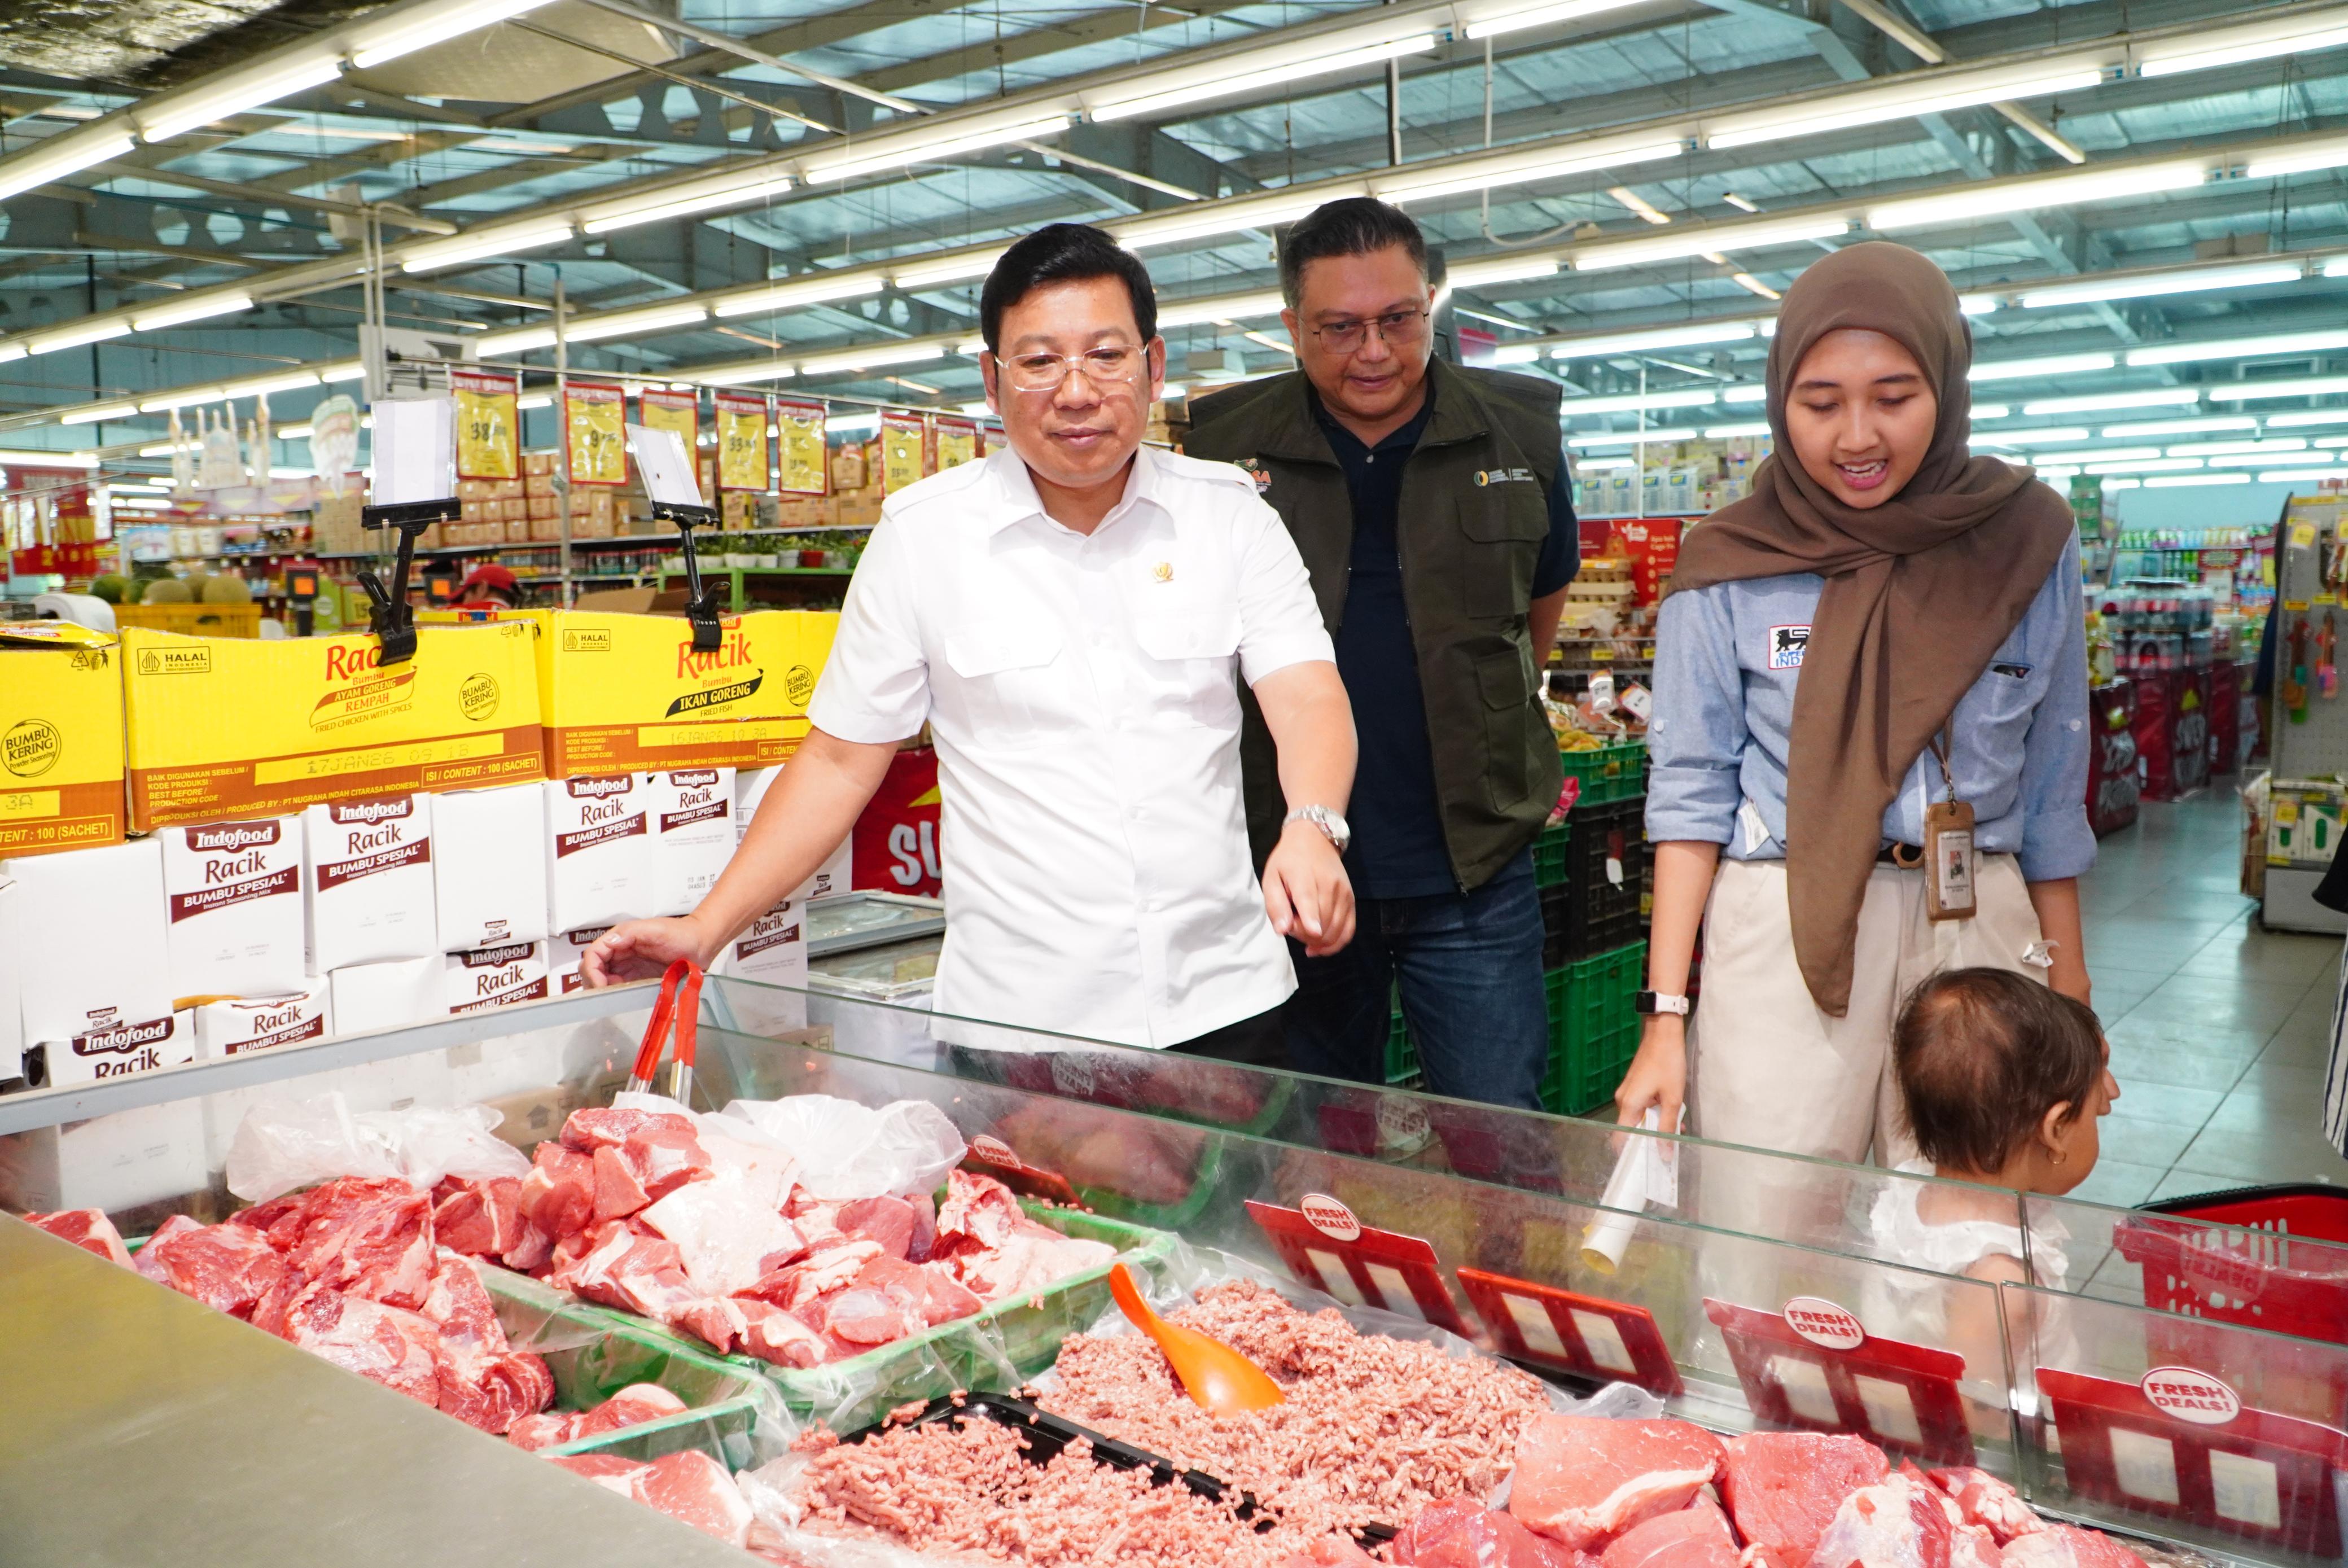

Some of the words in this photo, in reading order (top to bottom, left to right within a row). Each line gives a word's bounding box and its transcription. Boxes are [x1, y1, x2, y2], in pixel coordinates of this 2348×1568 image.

[165, 653, 207, 662] HALAL
[353, 672, 384, 686] Bumbu
[702, 677, 732, 688] Bumbu
[787, 671, 809, 687] BUMBU
[789, 679, 811, 695] KERING
[335, 689, 361, 702] AYAM
[363, 679, 396, 695] GORENG
[462, 680, 492, 699] BUMBU
[464, 689, 494, 709] KERING
[680, 693, 707, 710] IKAN
[711, 683, 751, 703] GORENG
[345, 693, 389, 712] REMPAH
[700, 707, 718, 717] FRIED
[719, 704, 733, 713] FISH
[316, 721, 336, 733] FRIED
[338, 713, 369, 728] CHICKEN
[370, 709, 389, 720] WITH
[390, 703, 413, 714] SPICES
[6, 727, 51, 751] BUMBU
[8, 738, 54, 762] KERING
[10, 759, 29, 770] Powder
[30, 751, 56, 764] Seasoning
[426, 770, 437, 782] ISI
[443, 765, 483, 779] CONTENT
[487, 763, 501, 774] 100
[502, 757, 537, 774] (SACHET)
[167, 770, 211, 781] DIGUNAKAN
[212, 767, 244, 777] SEBELUM
[674, 772, 716, 786] Indofood
[148, 782, 169, 790] KODE
[171, 779, 209, 789] PRODUKSI
[149, 790, 170, 799] BEST
[171, 788, 203, 798] BEFORE
[573, 778, 628, 797] Indofood
[150, 796, 198, 808] PRODUCTION
[199, 794, 218, 803] CODE
[151, 810, 199, 825] DIPRODUKSI
[200, 808, 221, 818] OLEH
[226, 801, 266, 814] PRODUCED
[267, 800, 278, 808] BY
[292, 792, 328, 804] NUGRAHA
[328, 790, 350, 799] INDAH
[351, 786, 384, 796] CITARASA
[384, 781, 419, 791] INDONESIA
[680, 788, 712, 808] Racik
[338, 800, 407, 822] Indofood
[581, 798, 624, 825] Racik
[667, 810, 696, 824] BUMBU
[37, 827, 55, 840] 100
[58, 822, 108, 840] (SACHET)
[196, 826, 274, 850] Indofood
[348, 824, 402, 855] Racik
[566, 827, 603, 846] BUMBU
[205, 851, 267, 884] Racik
[329, 857, 375, 877] BUMBU
[183, 886, 235, 908] BUMBU
[203, 900, 226, 910] Instant
[226, 893, 259, 905] Seasoning
[752, 914, 784, 937] Racik
[468, 944, 529, 965] Indofood
[743, 938, 769, 952] BUMBU
[477, 965, 524, 996] Racik
[92, 1017, 112, 1028] Racik
[253, 1005, 302, 1035] Racik
[83, 1021, 167, 1053] Indofood
[236, 1035, 278, 1053] BUMBU
[1304, 1208, 1350, 1220] FRESH
[1312, 1219, 1357, 1230] DEALS!
[1788, 1310, 1852, 1326] FRESH
[1794, 1323, 1859, 1338] DEALS!
[2148, 1382, 2227, 1399] FRESH
[2154, 1396, 2233, 1412] DEALS!
